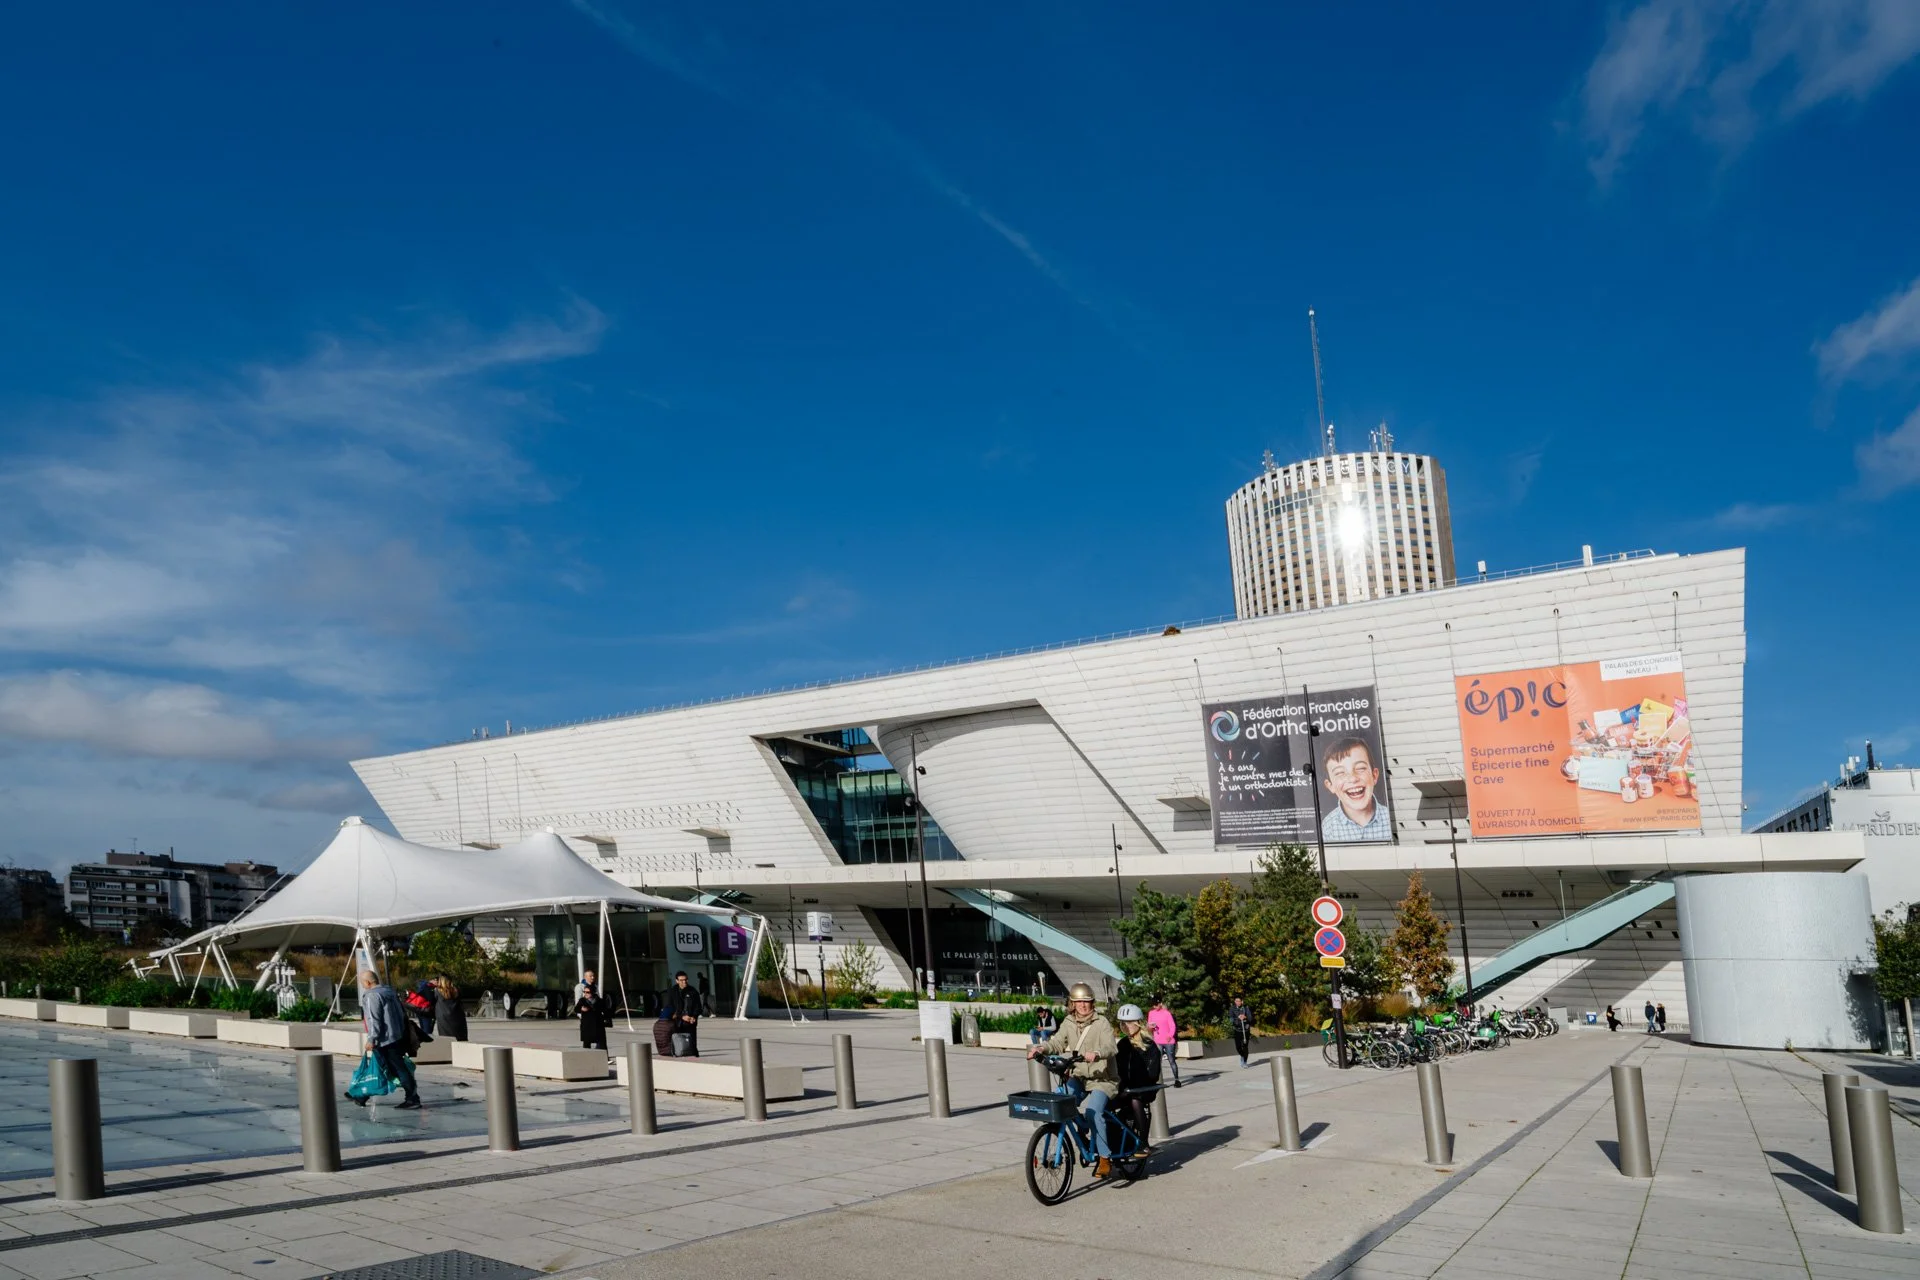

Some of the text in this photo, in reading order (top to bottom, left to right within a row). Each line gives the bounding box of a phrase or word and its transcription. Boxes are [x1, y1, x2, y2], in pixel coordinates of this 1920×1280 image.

[1625, 666, 1652, 675] NIVEAU
[1243, 698, 1370, 721] Fédération Française
[1470, 740, 1556, 759] Supermarché
[1228, 764, 1235, 772] 6
[1238, 764, 1257, 772] ans,
[1471, 757, 1550, 773] Épicerie fine
[1219, 772, 1230, 785] je
[1232, 771, 1266, 782] montre
[1269, 770, 1287, 779] mes
[1473, 774, 1505, 785] Cave
[1244, 778, 1308, 790] orthodontiste
[1476, 808, 1536, 819] OUVERT 7/7J
[1477, 816, 1586, 829] LIVRAISON À DOMICILE
[678, 933, 700, 944] RER
[727, 932, 739, 949] E
[942, 951, 952, 959] LE
